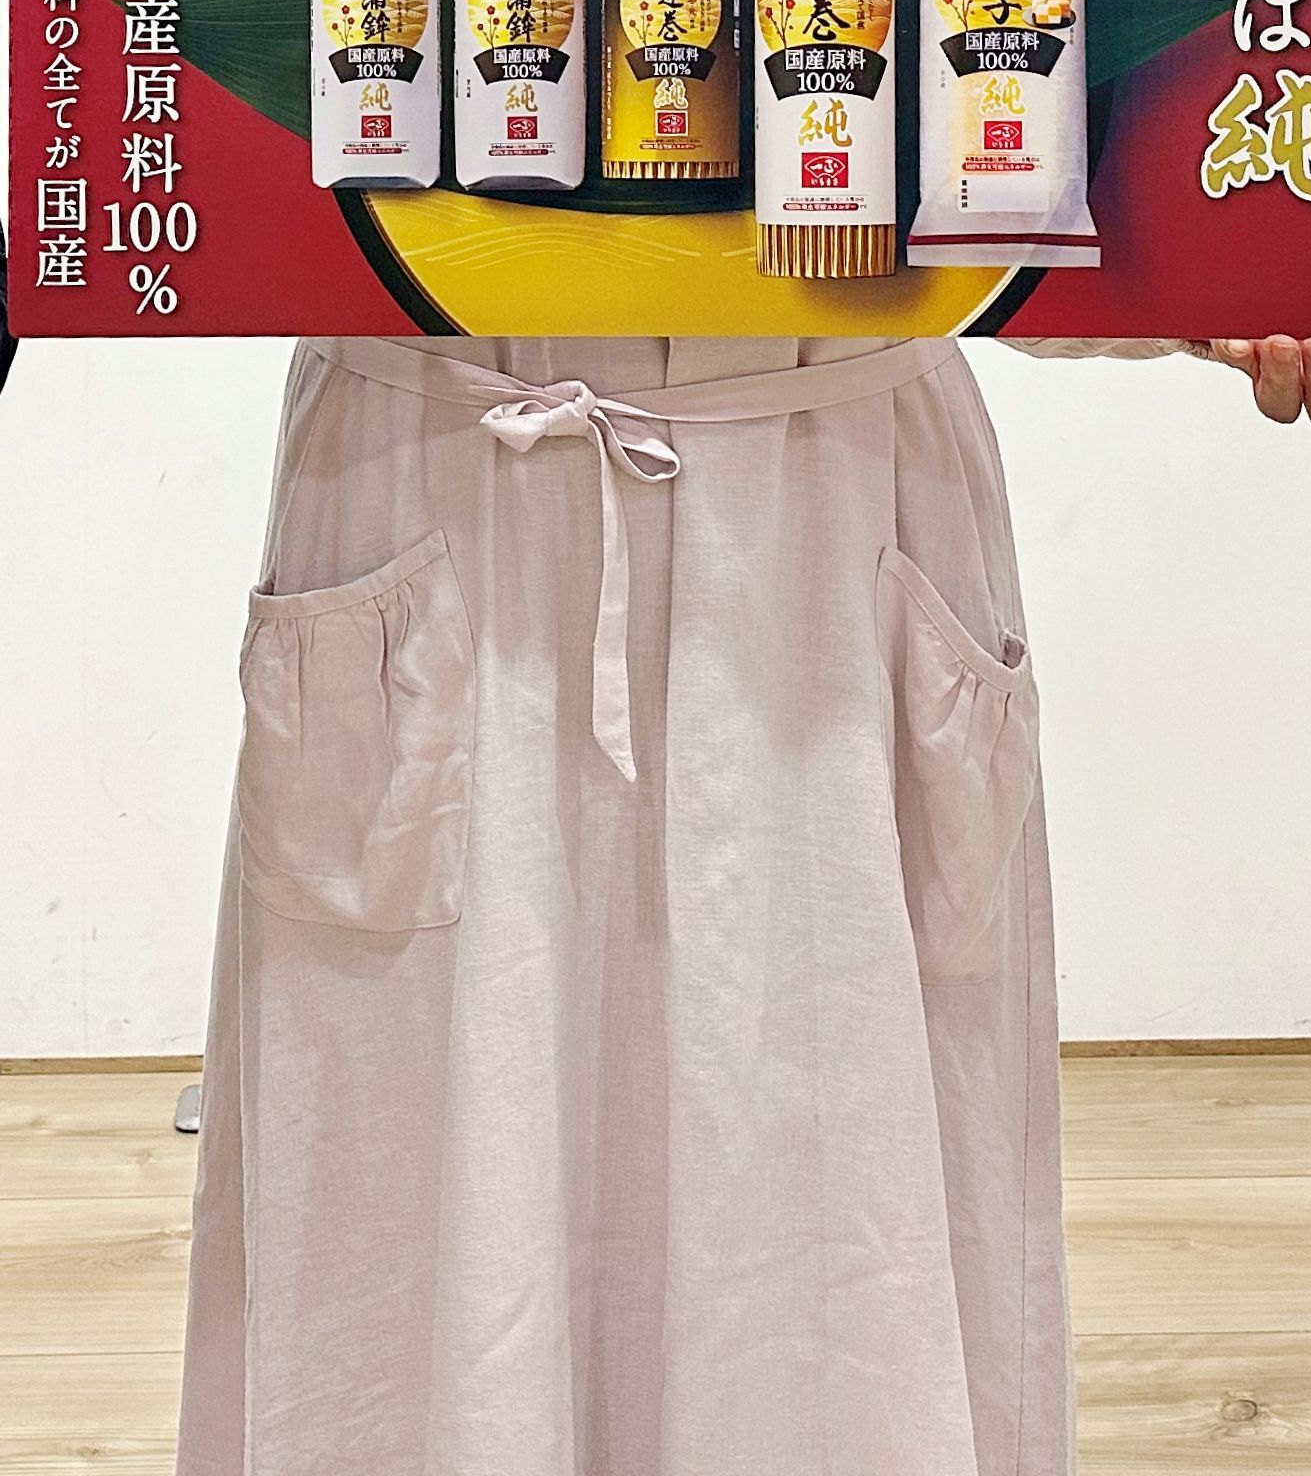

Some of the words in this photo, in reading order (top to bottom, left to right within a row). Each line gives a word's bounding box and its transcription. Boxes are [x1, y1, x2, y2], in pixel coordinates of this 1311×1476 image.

[965, 32, 1040, 51] 国産原料
[348, 47, 405, 63] 国産原料
[493, 47, 551, 64] 国産原料
[644, 47, 699, 62] 国産原料
[785, 48, 867, 71] 国産原料
[977, 53, 1029, 69] 100%
[356, 64, 397, 77] 100%
[502, 64, 543, 78] 100%
[652, 62, 691, 76] 100%
[797, 72, 855, 92] 100%
[980, 76, 1027, 115] 純
[798, 97, 853, 147] 純
